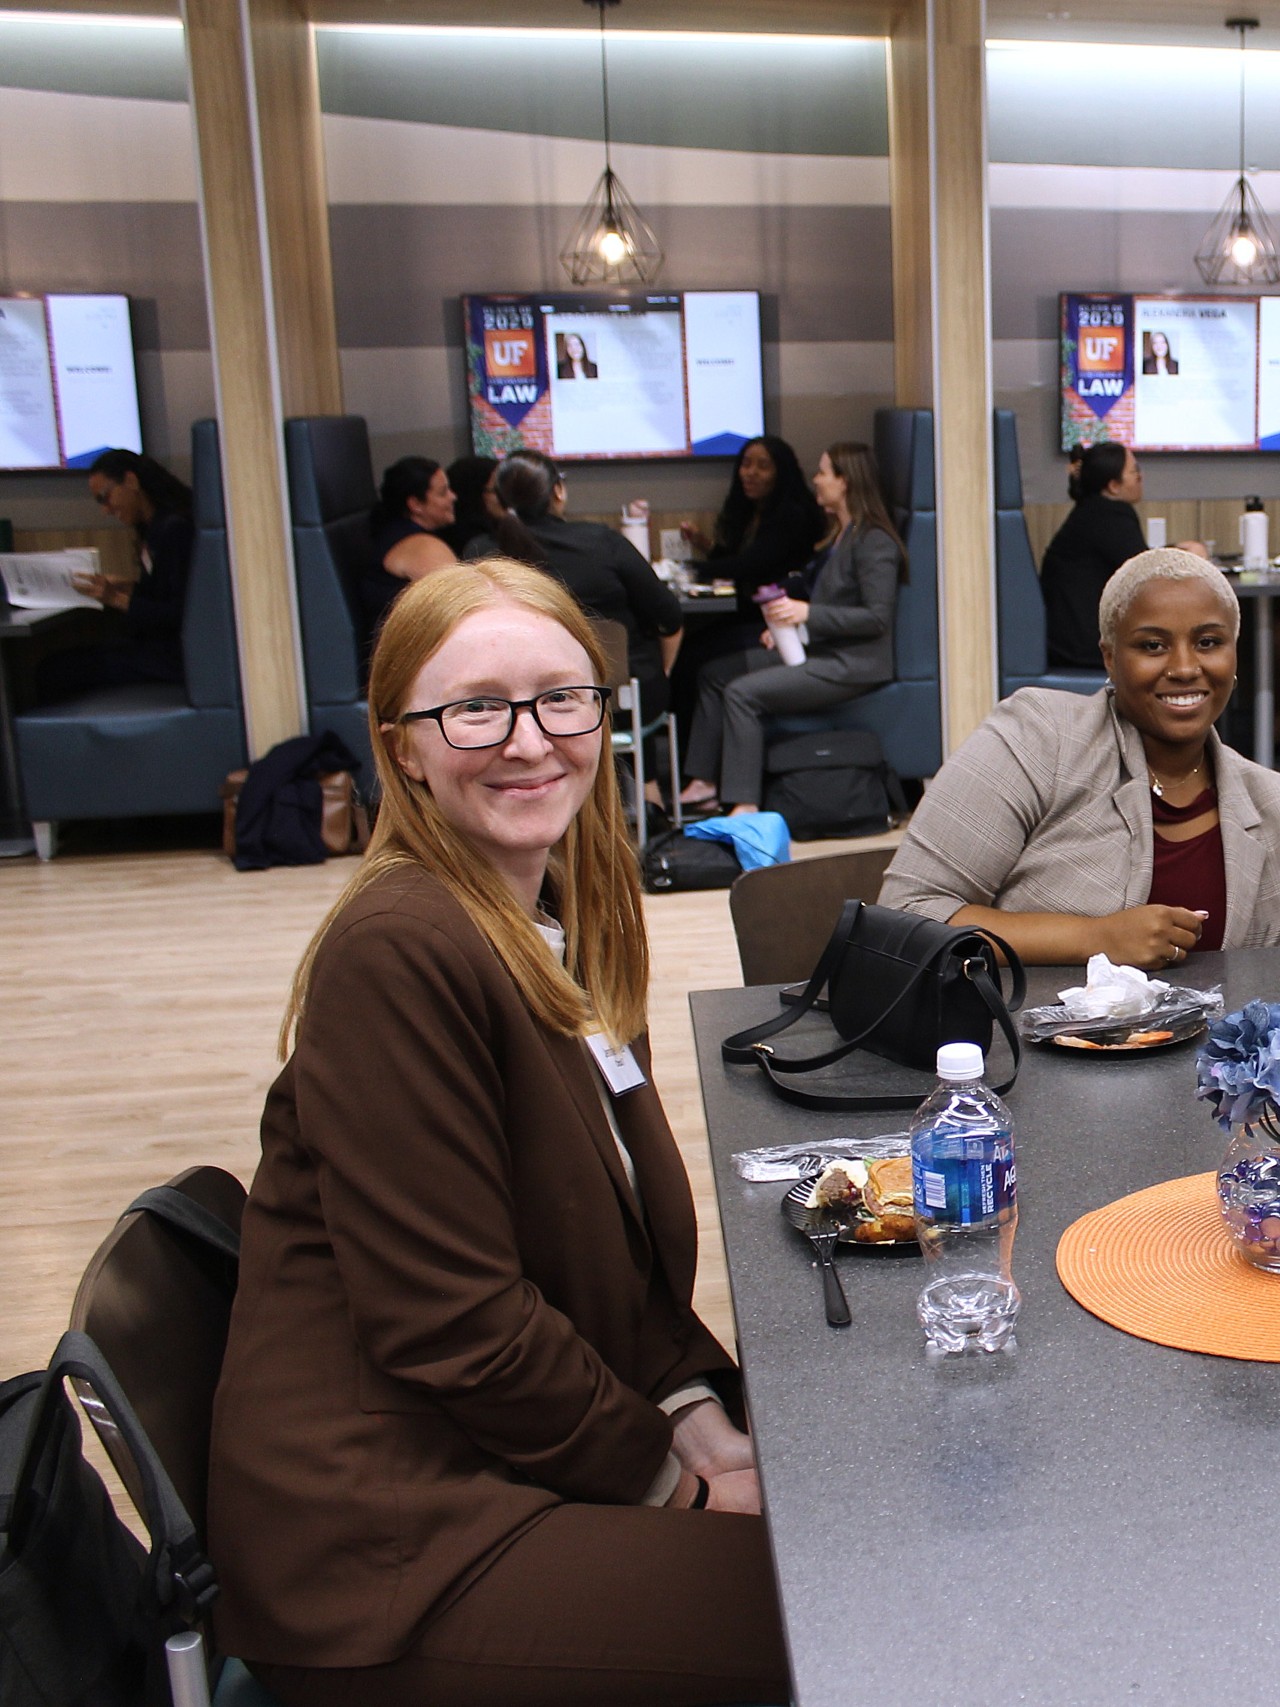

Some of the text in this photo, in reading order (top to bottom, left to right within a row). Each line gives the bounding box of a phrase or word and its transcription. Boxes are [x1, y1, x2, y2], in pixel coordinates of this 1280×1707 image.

[492, 341, 529, 366] UF
[1084, 338, 1118, 361] UF
[488, 385, 538, 404] LAW
[1078, 379, 1124, 397] LAW
[985, 1163, 995, 1214] RECYCLE
